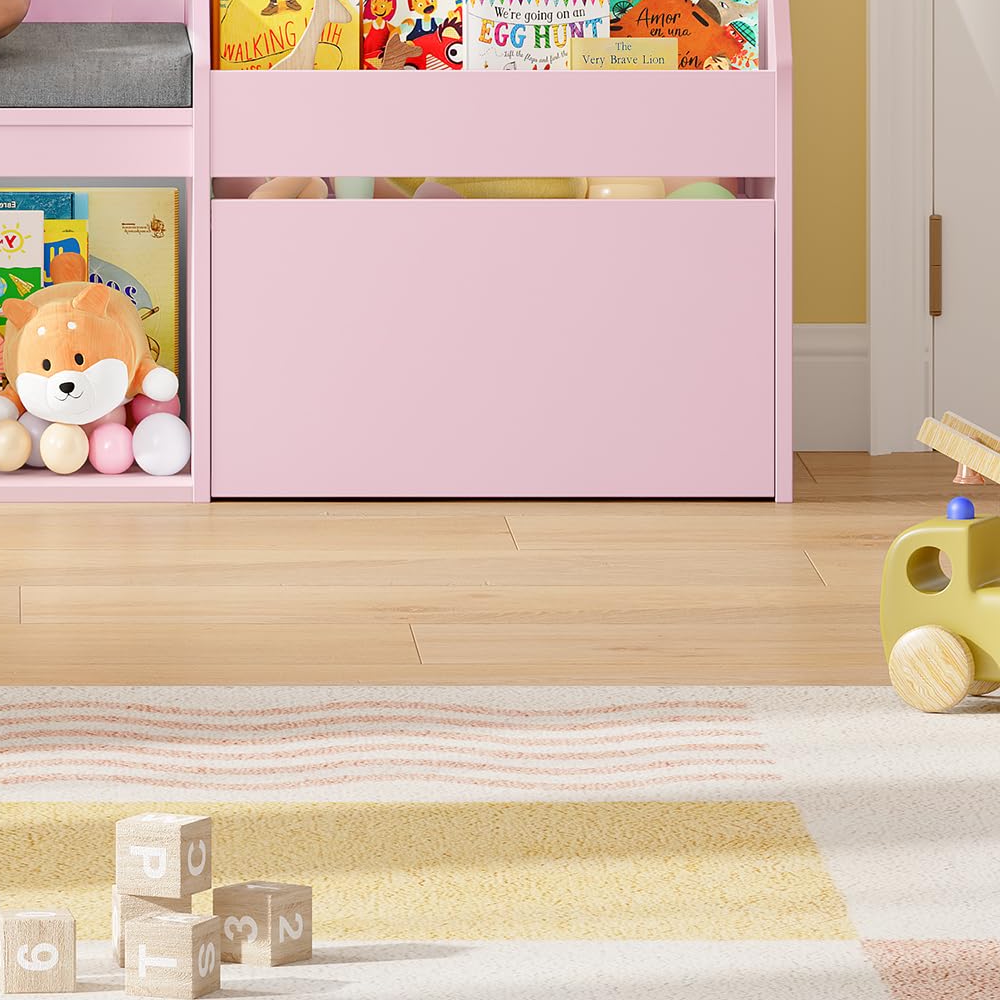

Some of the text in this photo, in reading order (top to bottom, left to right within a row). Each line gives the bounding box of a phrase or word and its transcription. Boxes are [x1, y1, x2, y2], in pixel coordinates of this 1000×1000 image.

[494, 7, 586, 23] We're going on an
[636, 7, 681, 28] Amor
[478, 17, 603, 49] EGG HUNT
[650, 28, 691, 37] en una
[223, 21, 297, 62] WALKING
[615, 42, 632, 51] The
[582, 55, 665, 67] Very Brave Lion
